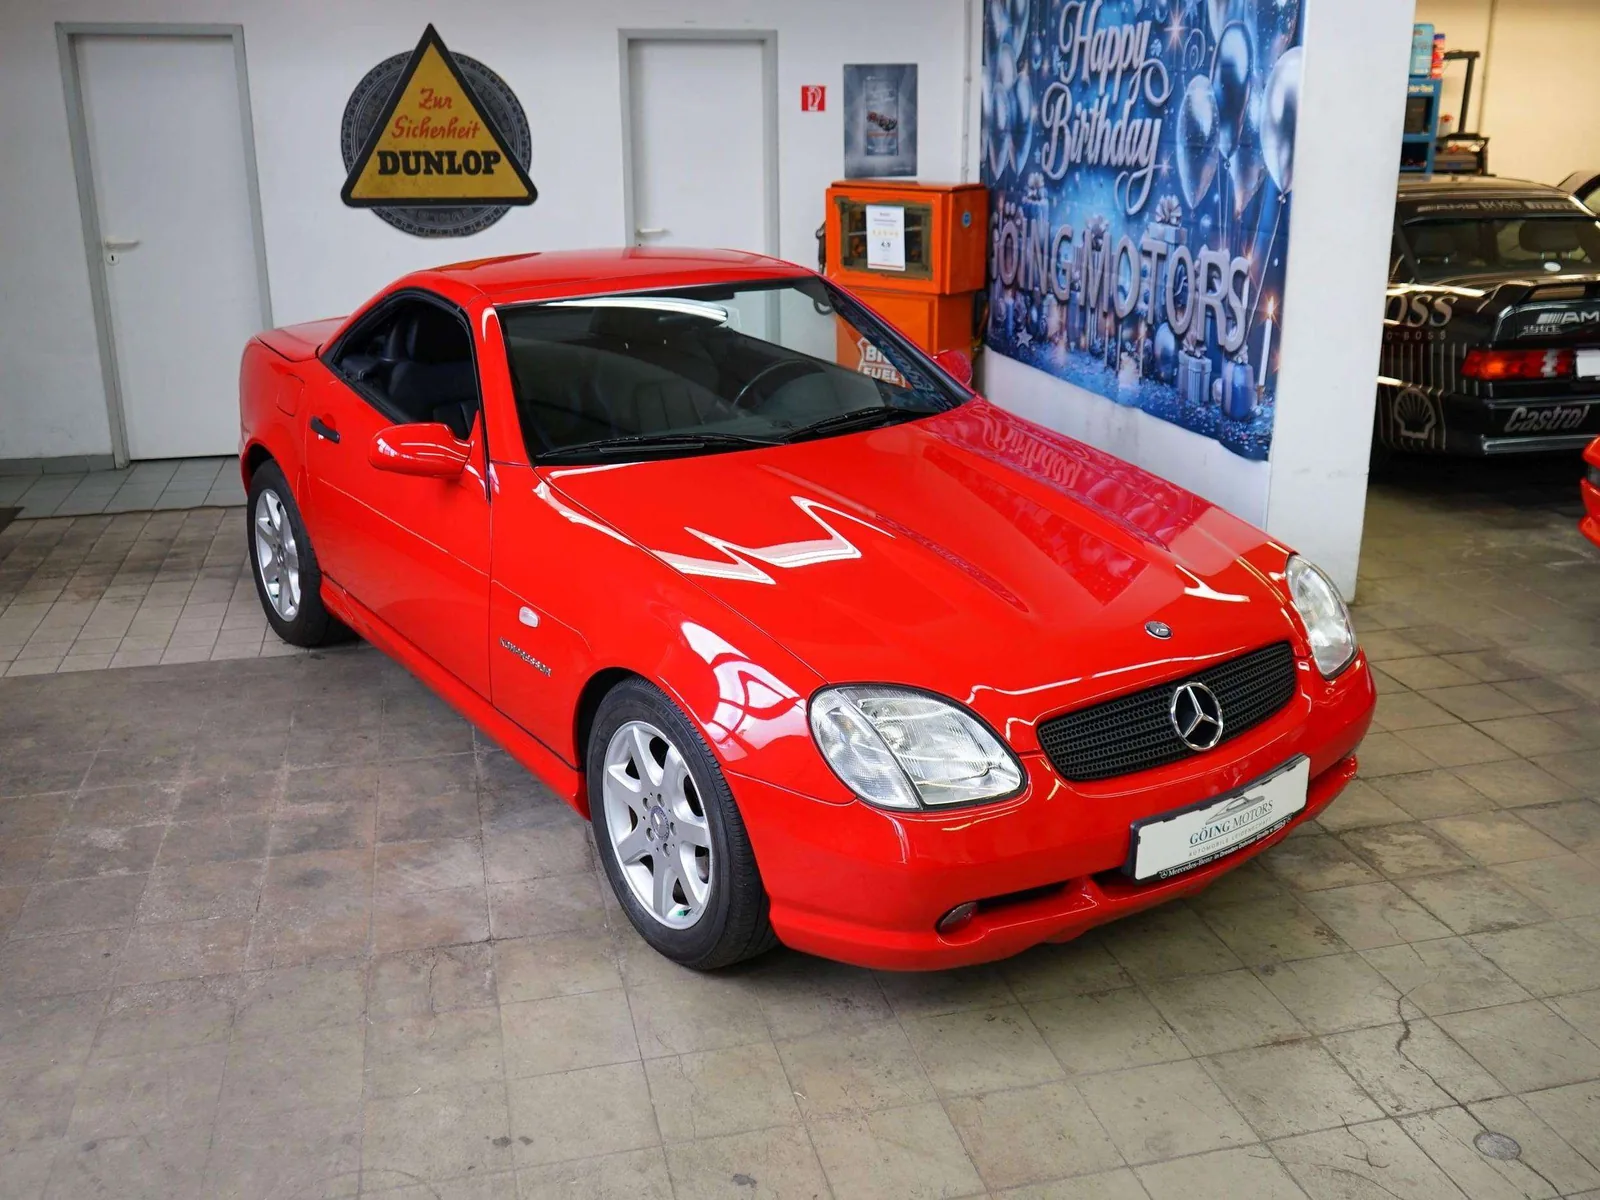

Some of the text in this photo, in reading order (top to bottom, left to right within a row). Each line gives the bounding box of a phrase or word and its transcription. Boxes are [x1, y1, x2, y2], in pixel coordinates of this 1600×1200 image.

[1058, 0, 1171, 107] Happy
[418, 87, 453, 110] Zur
[391, 113, 481, 140] Sicherheit
[1041, 82, 1163, 215] Birthday
[377, 150, 503, 175] DUNLOP
[1078, 228, 1251, 352] MOTORS
[1560, 310, 1600, 324] AM
[862, 366, 901, 383] FUEL
[1504, 404, 1591, 433] Castrol
[1189, 820, 1231, 845] GÖING
[1233, 800, 1274, 827] MOTORS
[1188, 838, 1230, 857] AUTOMOBILE
